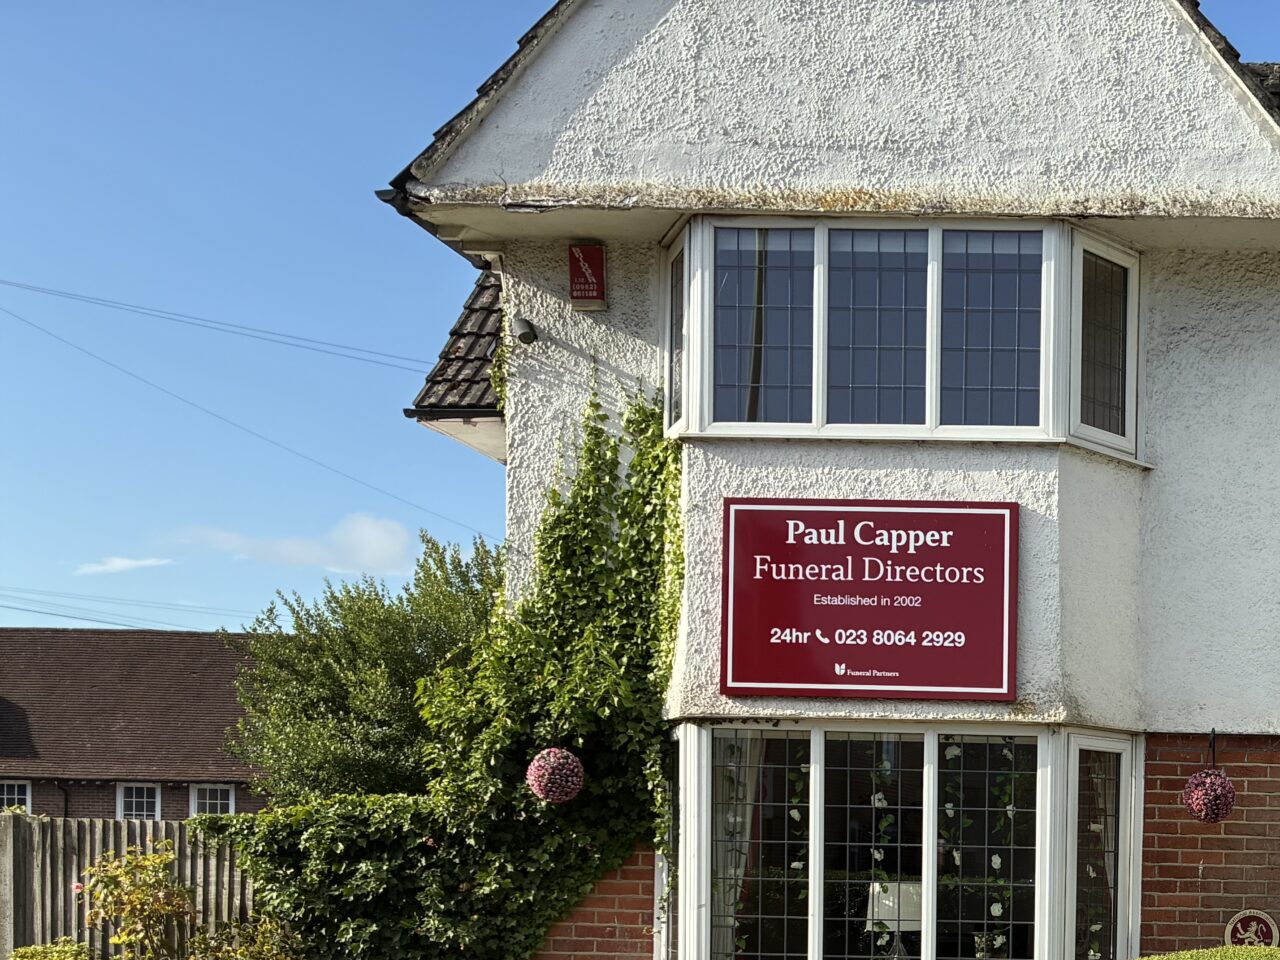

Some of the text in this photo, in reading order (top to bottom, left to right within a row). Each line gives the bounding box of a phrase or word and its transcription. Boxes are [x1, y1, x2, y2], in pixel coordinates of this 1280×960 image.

[785, 519, 953, 553] Paul Capper
[753, 555, 985, 584] Funeral Directors
[813, 593, 922, 607] Established in 2002
[769, 627, 966, 647] 24hr 023 8064 2929
[847, 668, 900, 677] Funeral Partners
